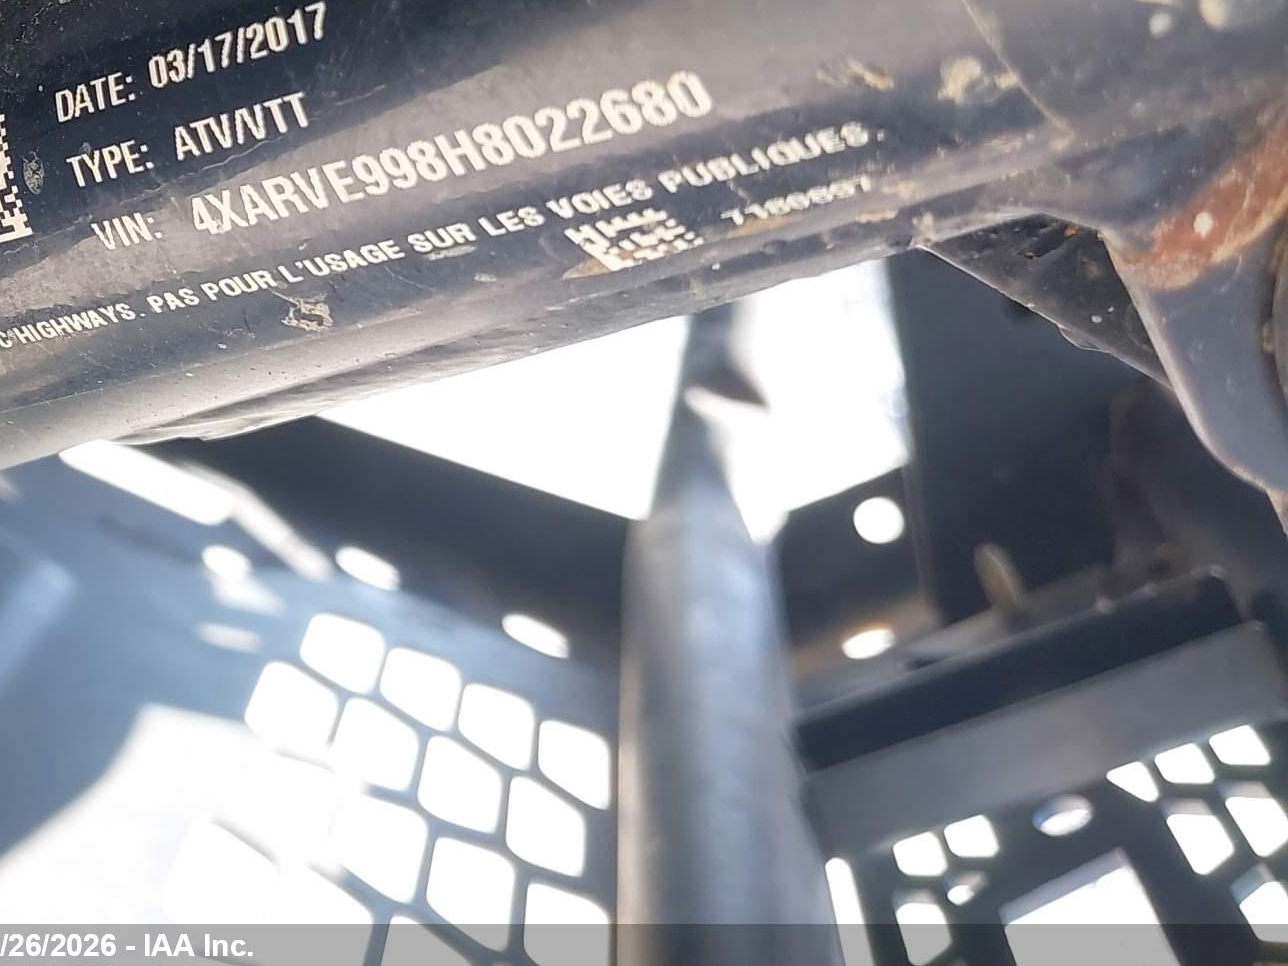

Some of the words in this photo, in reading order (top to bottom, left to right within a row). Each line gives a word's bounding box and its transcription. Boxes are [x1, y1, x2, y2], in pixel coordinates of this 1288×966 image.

[55, 72, 136, 123] DATE:
[148, 0, 327, 88] 03/17/2017
[66, 139, 154, 187] TYPE:
[174, 91, 310, 161] ATV/VTT
[90, 211, 163, 250] VIN:
[190, 70, 713, 236] 4XARVE998H8022680
[14, 302, 147, 346] HIGHWAYS.
[146, 287, 200, 314] PAS
[200, 269, 278, 302] POUR
[277, 239, 406, 284] L'USAGE
[407, 222, 477, 254] SUR
[478, 205, 546, 238] LES
[546, 177, 654, 220] VOIES
[657, 120, 885, 194] PUBLIQUES.
